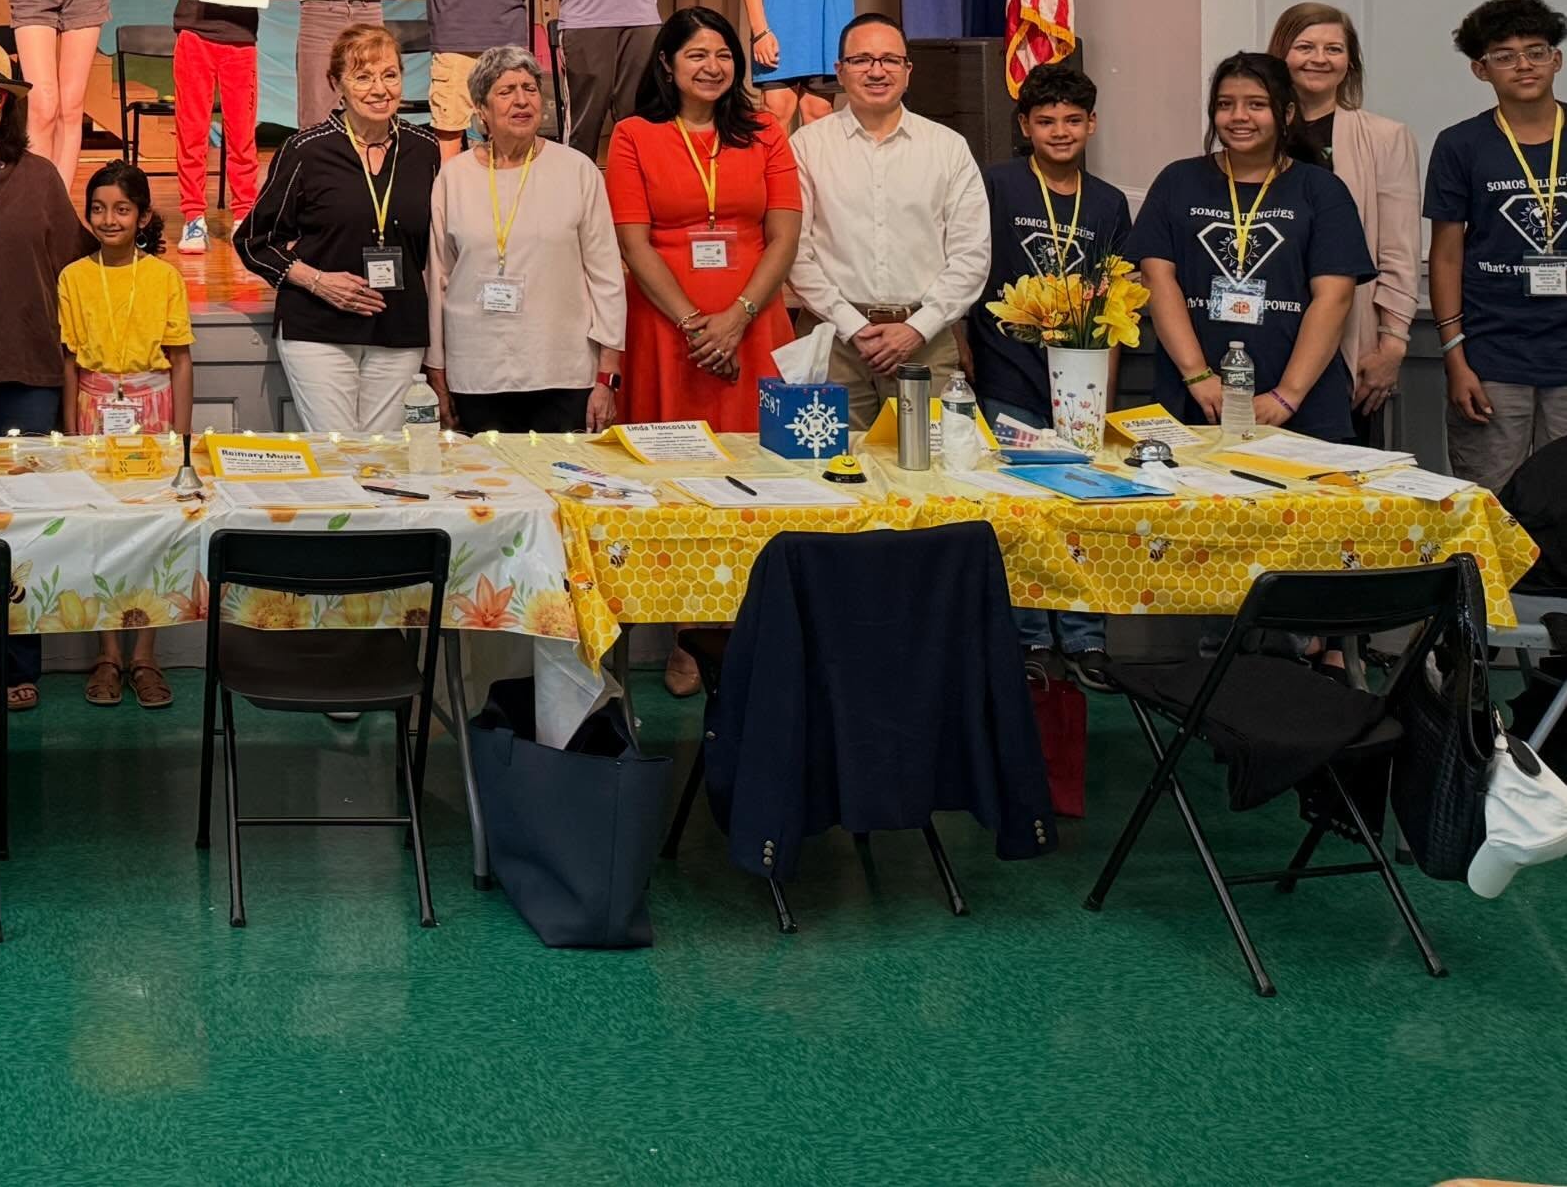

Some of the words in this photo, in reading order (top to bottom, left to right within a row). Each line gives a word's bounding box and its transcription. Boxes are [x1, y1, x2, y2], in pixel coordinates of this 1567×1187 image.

[1487, 179, 1527, 192] SOMOS
[1190, 207, 1231, 220] SOMOS
[1014, 217, 1048, 229] SOMOS
[1478, 261, 1511, 273] What's
[759, 389, 781, 418] PS87
